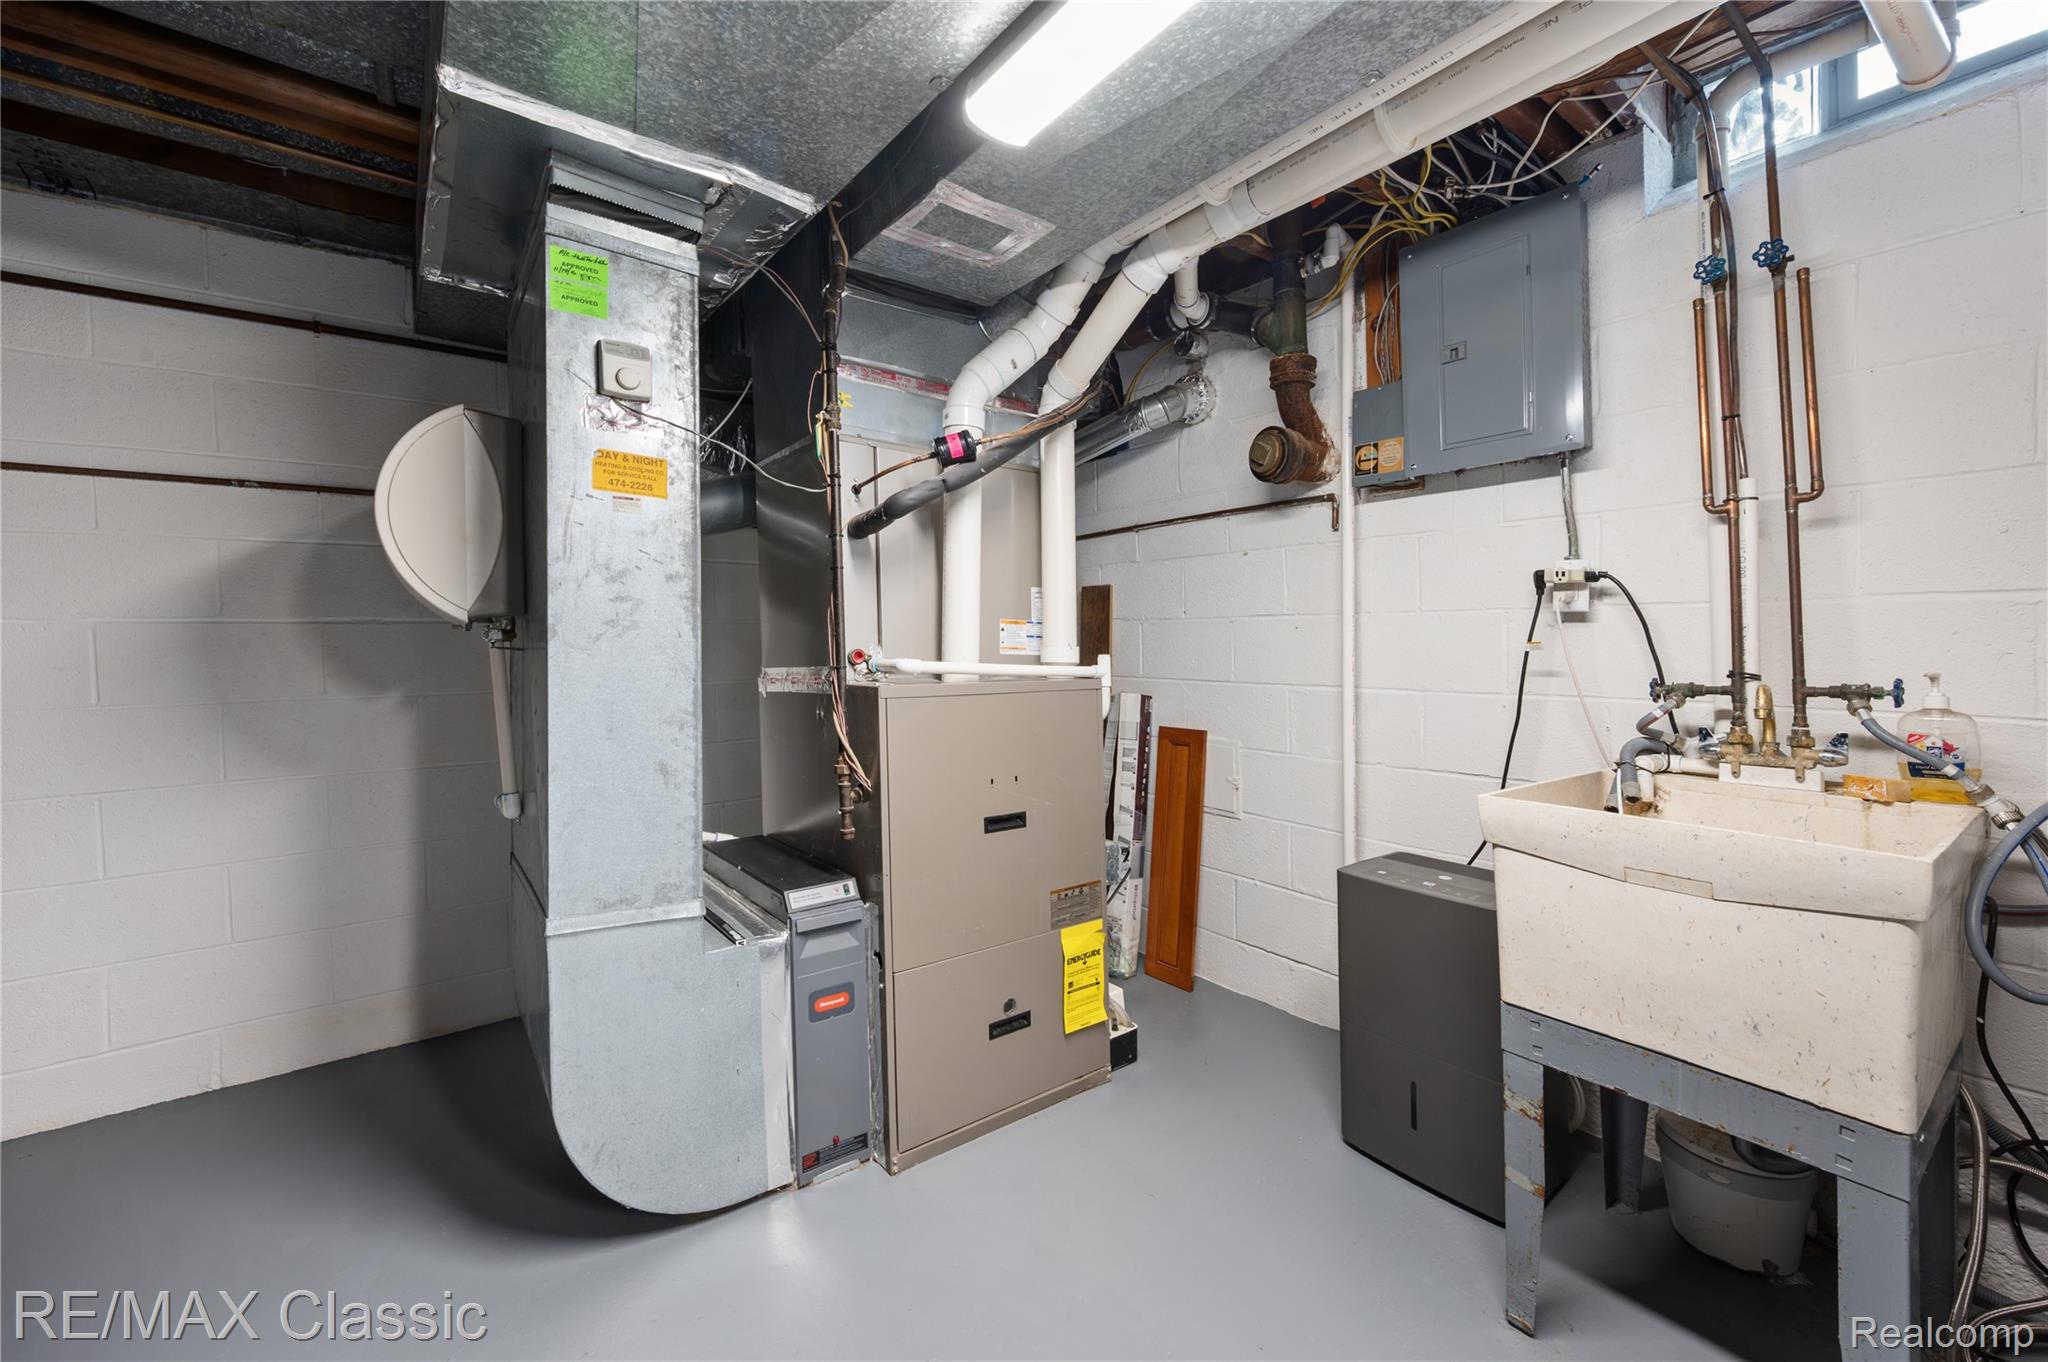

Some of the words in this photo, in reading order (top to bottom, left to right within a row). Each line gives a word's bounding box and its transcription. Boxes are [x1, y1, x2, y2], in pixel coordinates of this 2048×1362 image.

[1371, 51, 1454, 97] CHARLOTTE
[561, 262, 599, 274] APPROVED
[560, 294, 599, 307] APPROVED
[594, 461, 622, 470] HEATING
[622, 454, 629, 462] &
[632, 456, 665, 467] NIGHT
[603, 468, 616, 476] FOR
[617, 470, 642, 479] SERVICE
[607, 478, 653, 492] 474-2226
